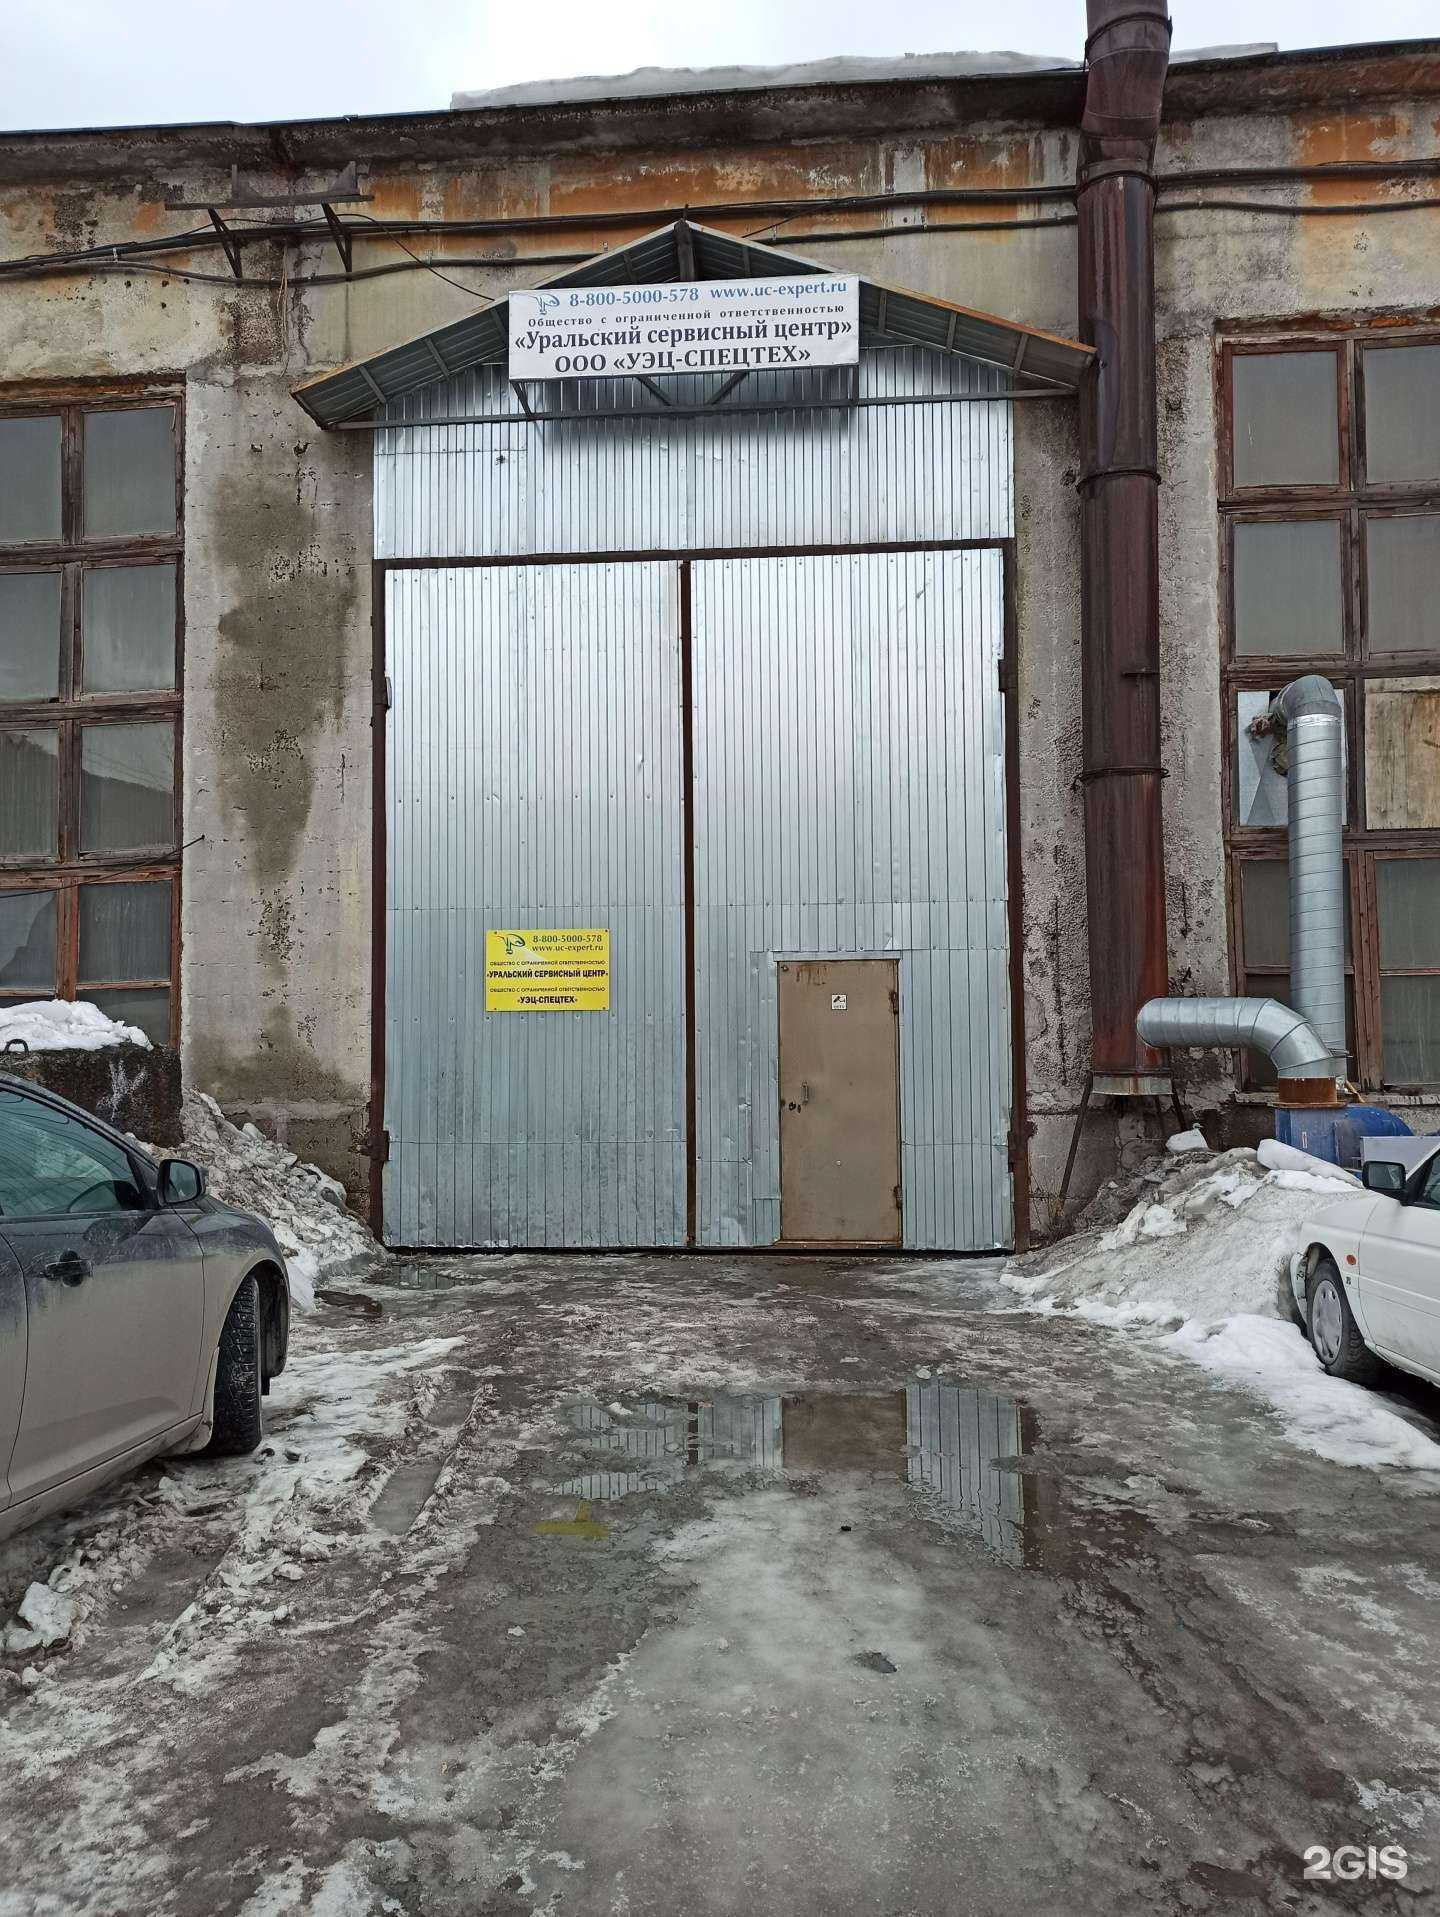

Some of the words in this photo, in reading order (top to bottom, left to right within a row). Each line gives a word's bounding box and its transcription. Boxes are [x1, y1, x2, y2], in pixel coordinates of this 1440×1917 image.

[569, 287, 699, 307] 8-800-5000-578
[710, 281, 847, 300] www.uc-expert.ru
[528, 315, 592, 328] Общество
[615, 309, 711, 325] ограниченной
[720, 304, 845, 318] ответственностью
[515, 326, 641, 353] «Уральский
[647, 320, 768, 347] сервисный
[774, 321, 852, 340] центр»
[555, 353, 607, 373] ООО
[613, 344, 811, 371] «УЭЦ-СПЕЦТЕХ»
[532, 935, 602, 943] 8-800-5000-578
[532, 945, 604, 953] www.uc-expert.ru
[534, 968, 581, 978] СЕРВИСНЫЙ
